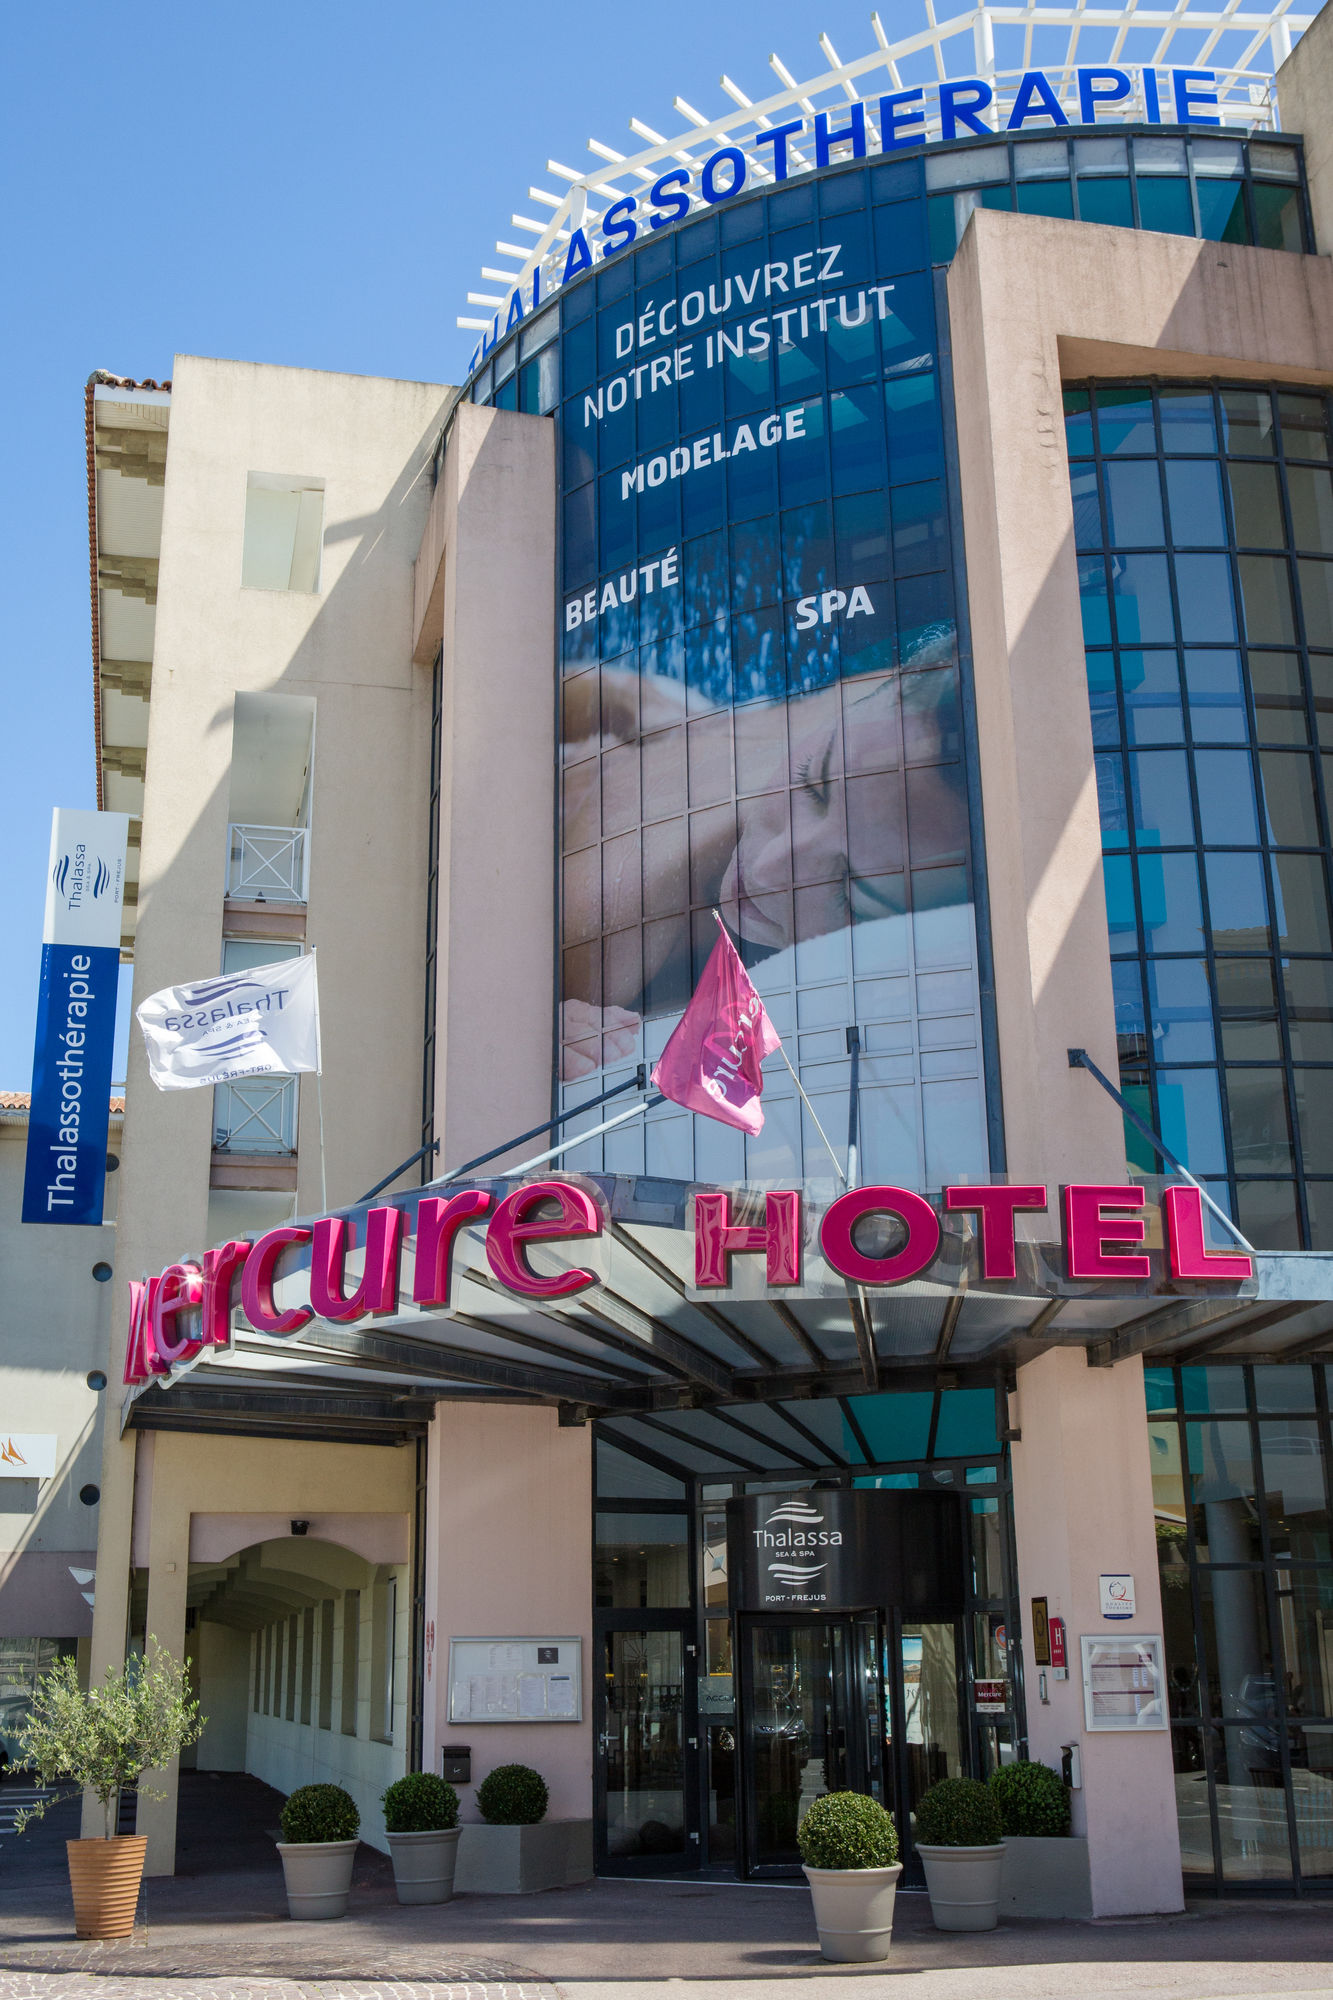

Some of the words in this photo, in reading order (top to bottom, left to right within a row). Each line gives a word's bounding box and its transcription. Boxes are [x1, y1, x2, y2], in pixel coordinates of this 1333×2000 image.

[615, 244, 844, 359] DÉCOUVREZ
[583, 345, 694, 428] NOTRE
[706, 284, 896, 367] INSTITUT
[621, 408, 806, 500] MODELAGE
[565, 547, 680, 632] BEAUTÉ
[796, 585, 876, 630] SPA
[68, 844, 86, 910] Thalassa
[47, 954, 96, 1211] Thalassothérapie
[695, 1184, 1253, 1288] HOTEL
[753, 1527, 843, 1548] Thalassa
